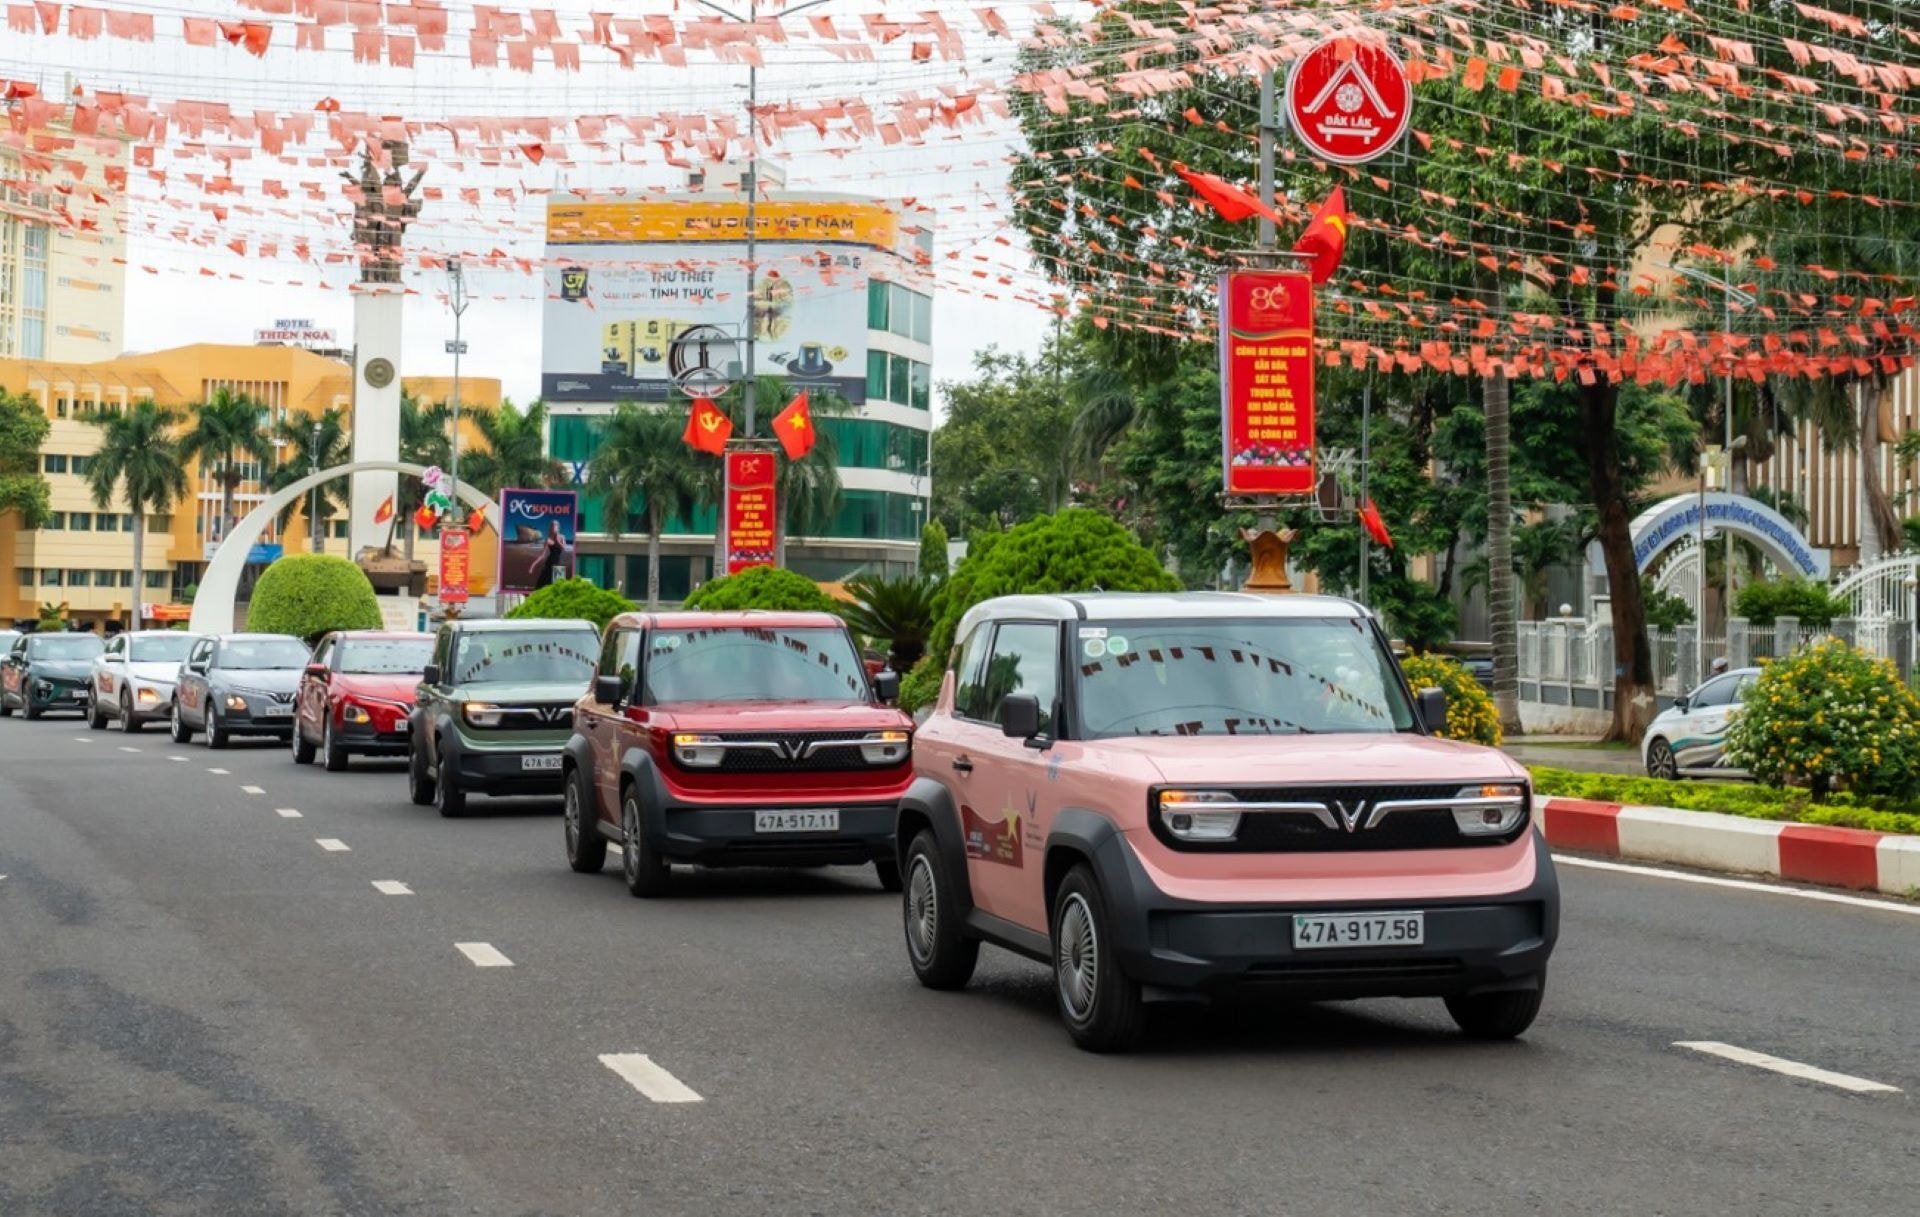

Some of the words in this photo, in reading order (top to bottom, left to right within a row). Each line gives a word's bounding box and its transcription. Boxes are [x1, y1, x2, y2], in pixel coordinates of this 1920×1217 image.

[816, 217, 853, 229] NAM
[276, 319, 312, 328] HOTEL
[303, 331, 329, 340] NGA
[758, 814, 835, 829] 47A-517.11
[1299, 918, 1419, 943] 47A-917.58
